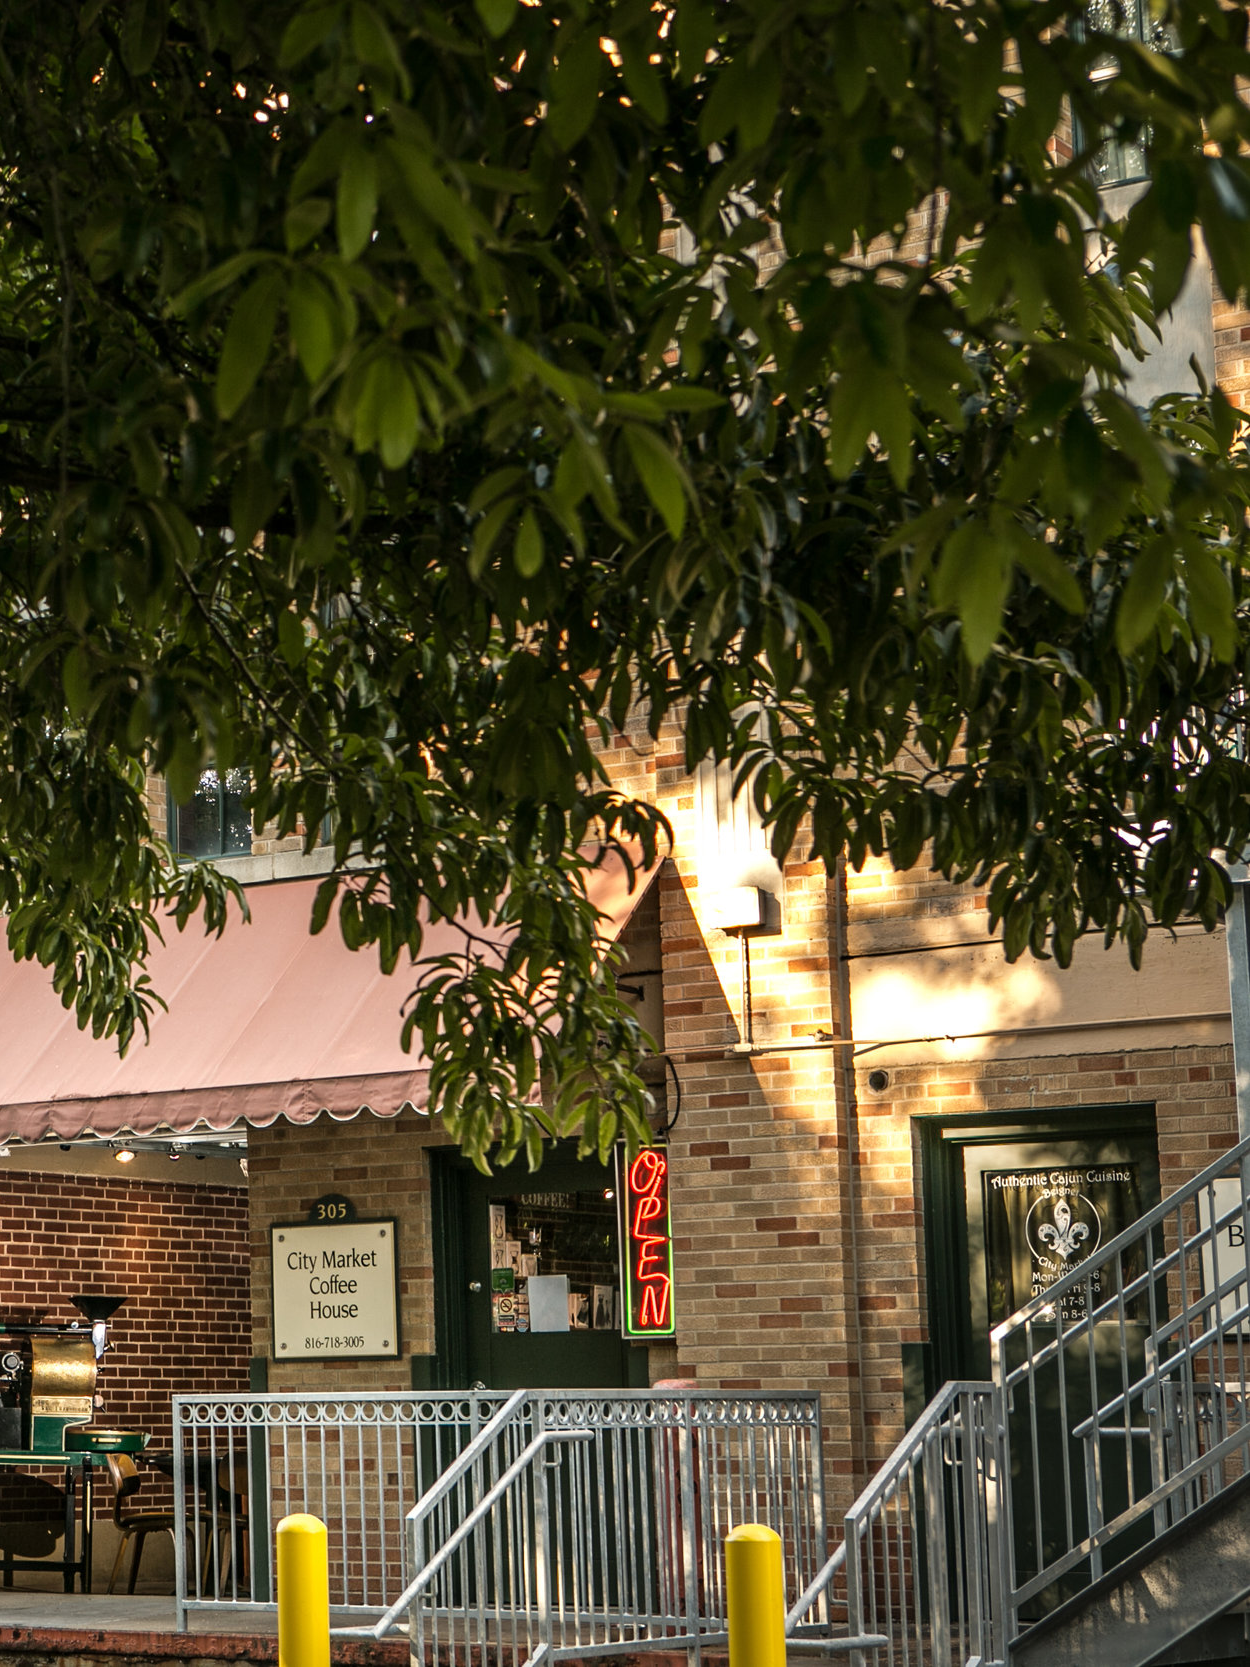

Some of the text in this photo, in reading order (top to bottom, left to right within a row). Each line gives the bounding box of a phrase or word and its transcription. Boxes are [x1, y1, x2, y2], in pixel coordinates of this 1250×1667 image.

[991, 1170, 1131, 1189] Authentic Cajun Cuisine
[317, 1203, 347, 1220] 305
[630, 1150, 671, 1326] OPEN
[287, 1248, 377, 1273] City Market
[1038, 1256, 1057, 1271] City
[309, 1274, 358, 1295] Coffee
[1069, 1296, 1085, 1306] 7-8
[310, 1301, 359, 1319] House
[1071, 1309, 1088, 1319] 8-6
[304, 1336, 365, 1349] 816-718-3005
